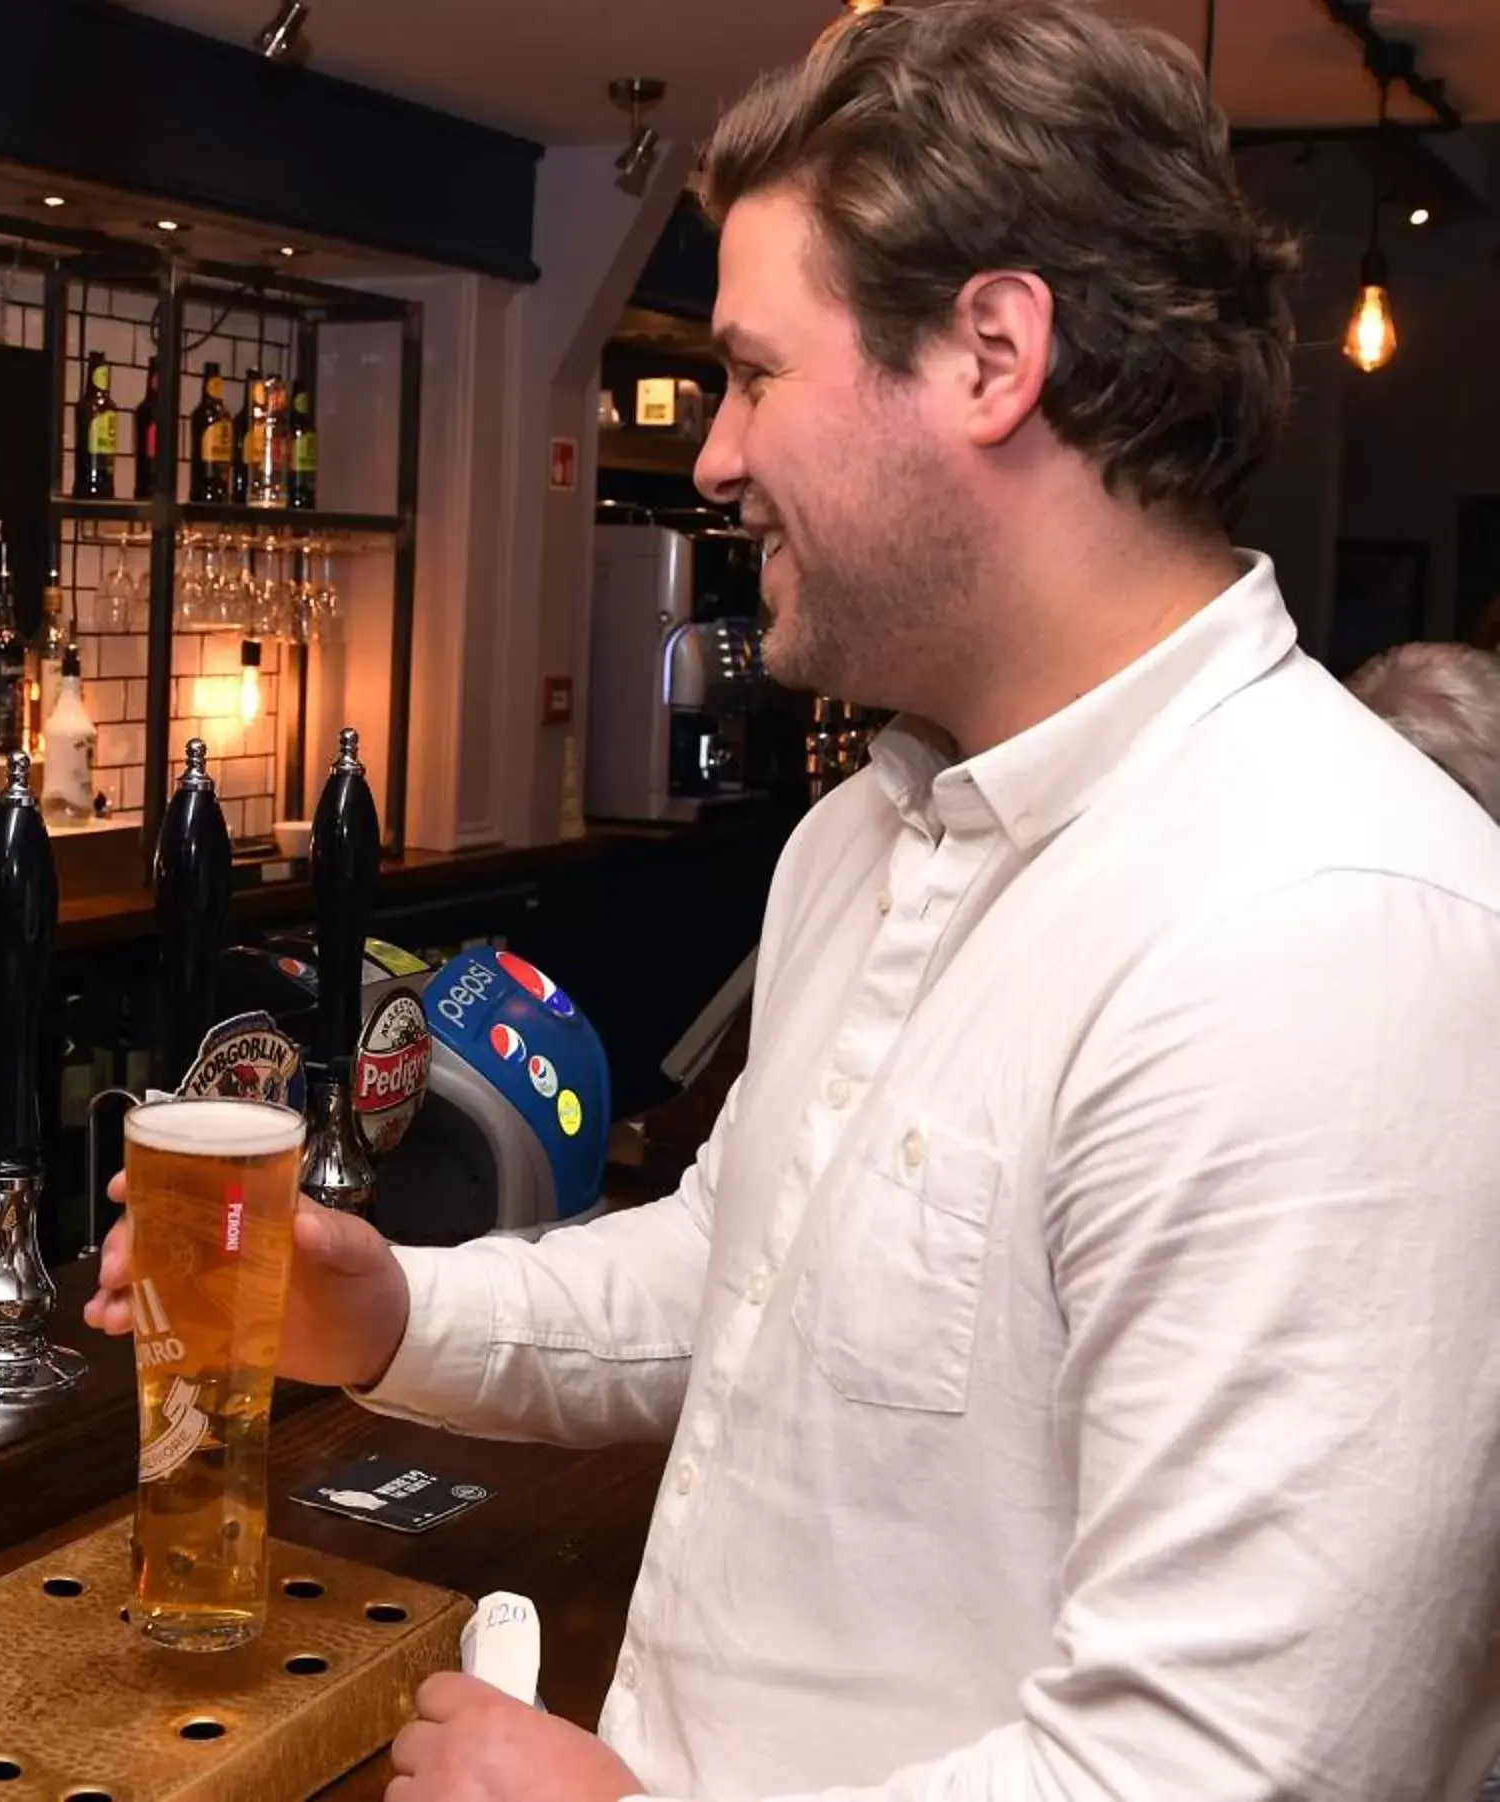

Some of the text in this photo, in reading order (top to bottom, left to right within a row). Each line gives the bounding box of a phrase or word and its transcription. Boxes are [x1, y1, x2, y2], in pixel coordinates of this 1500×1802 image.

[437, 959, 498, 1030] pepsi
[192, 1037, 287, 1096] HOBGOBLIN
[226, 1202, 243, 1252] PERONI
